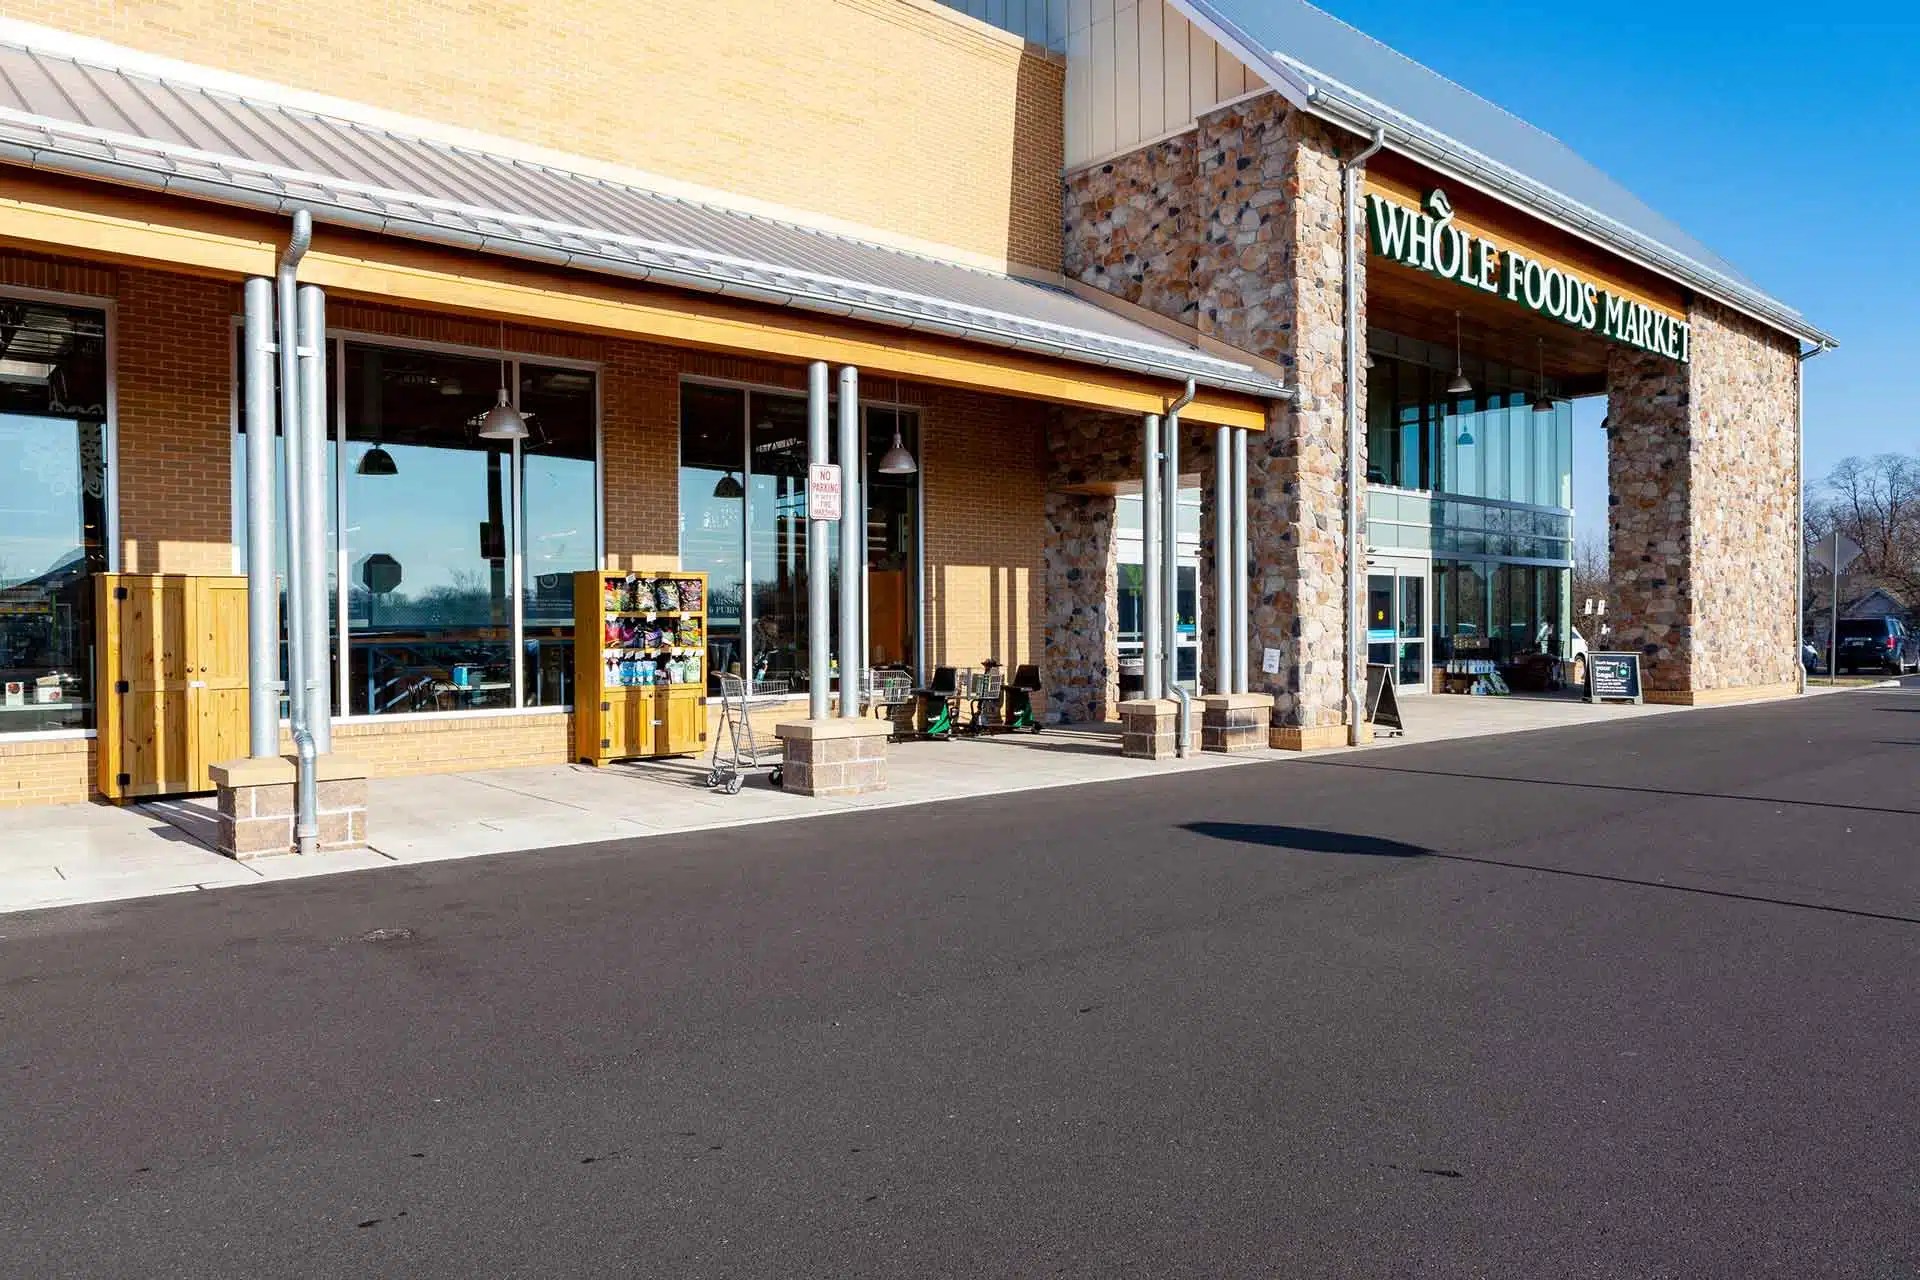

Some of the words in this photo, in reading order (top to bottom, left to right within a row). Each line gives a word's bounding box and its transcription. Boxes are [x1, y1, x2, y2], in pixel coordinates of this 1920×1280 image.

[1369, 189, 1499, 293] WHOLE
[1507, 250, 1598, 330] FOODS
[1602, 290, 1692, 364] MARKET
[819, 471, 831, 481] NO
[811, 483, 840, 493] PARKING
